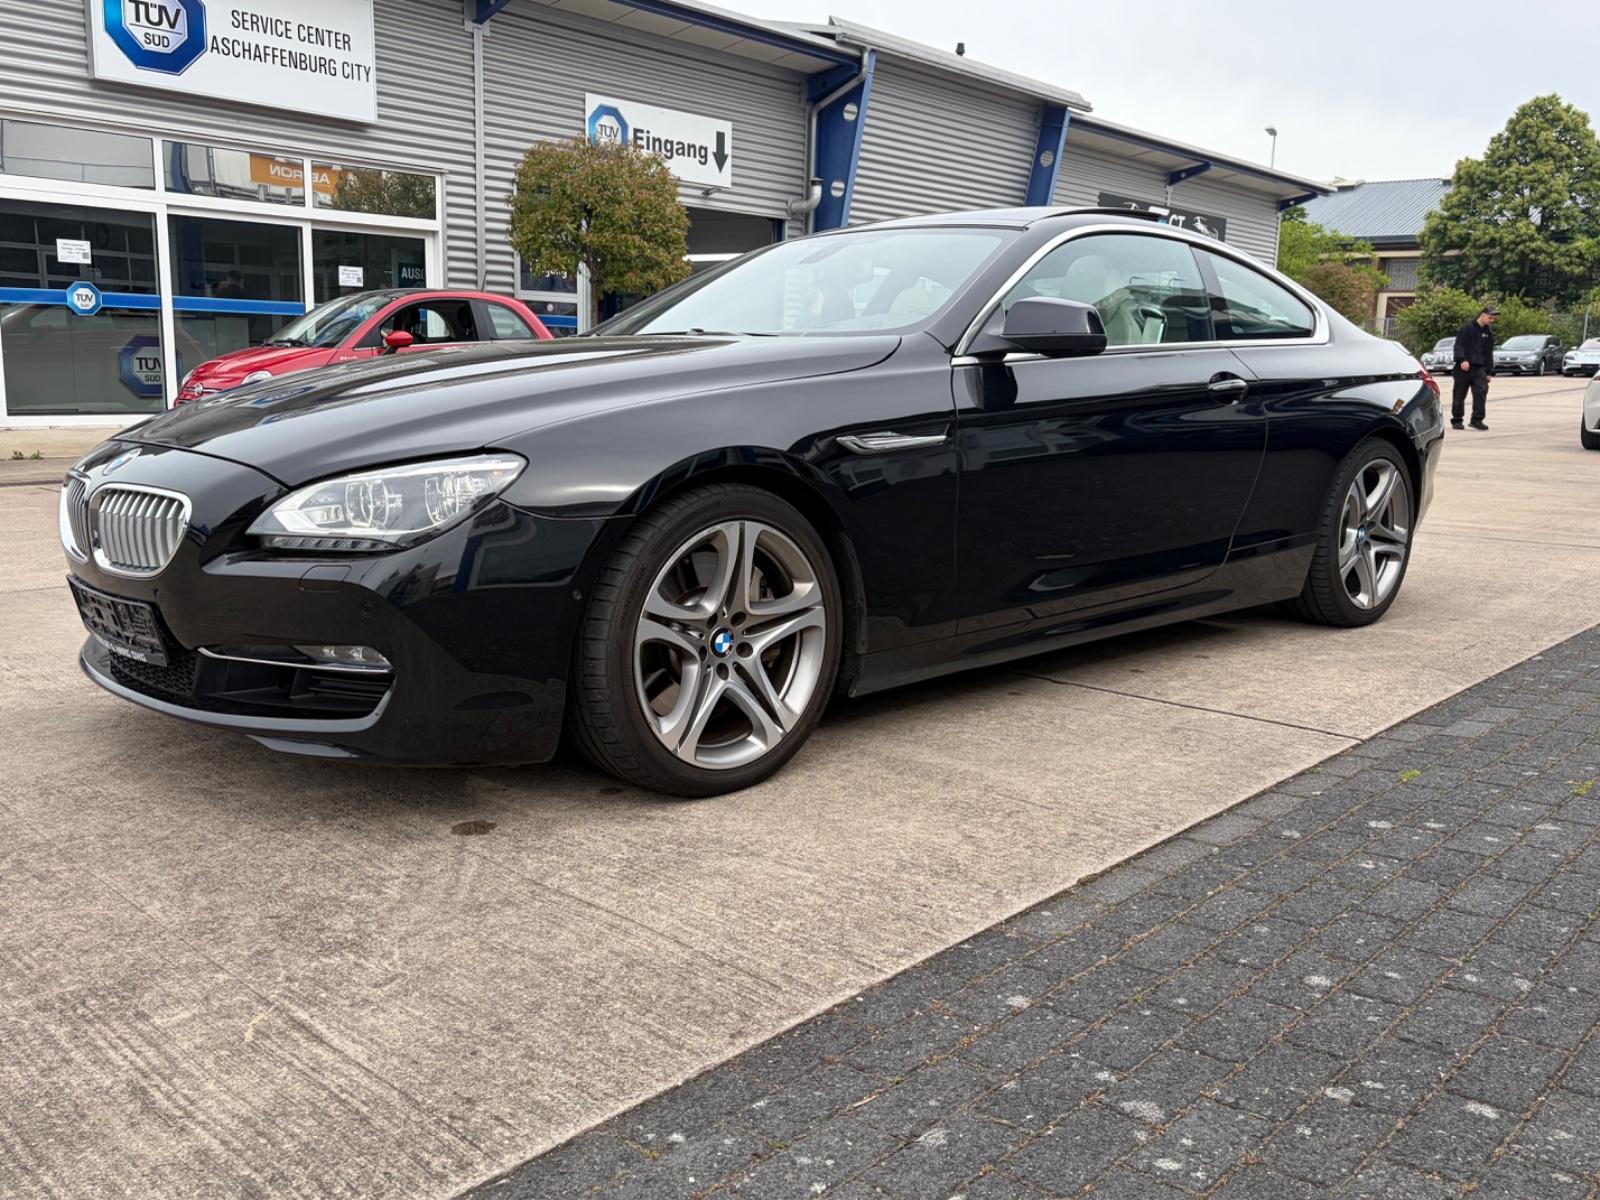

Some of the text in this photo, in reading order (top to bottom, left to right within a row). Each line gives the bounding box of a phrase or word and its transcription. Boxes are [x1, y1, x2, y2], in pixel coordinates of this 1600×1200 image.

[128, 0, 181, 30] TÜV
[231, 9, 351, 51] SERVICE CENTER
[143, 32, 170, 48] SÜD
[210, 35, 372, 83] ASCHAFFENBURG CITY
[632, 127, 708, 165] Eingang
